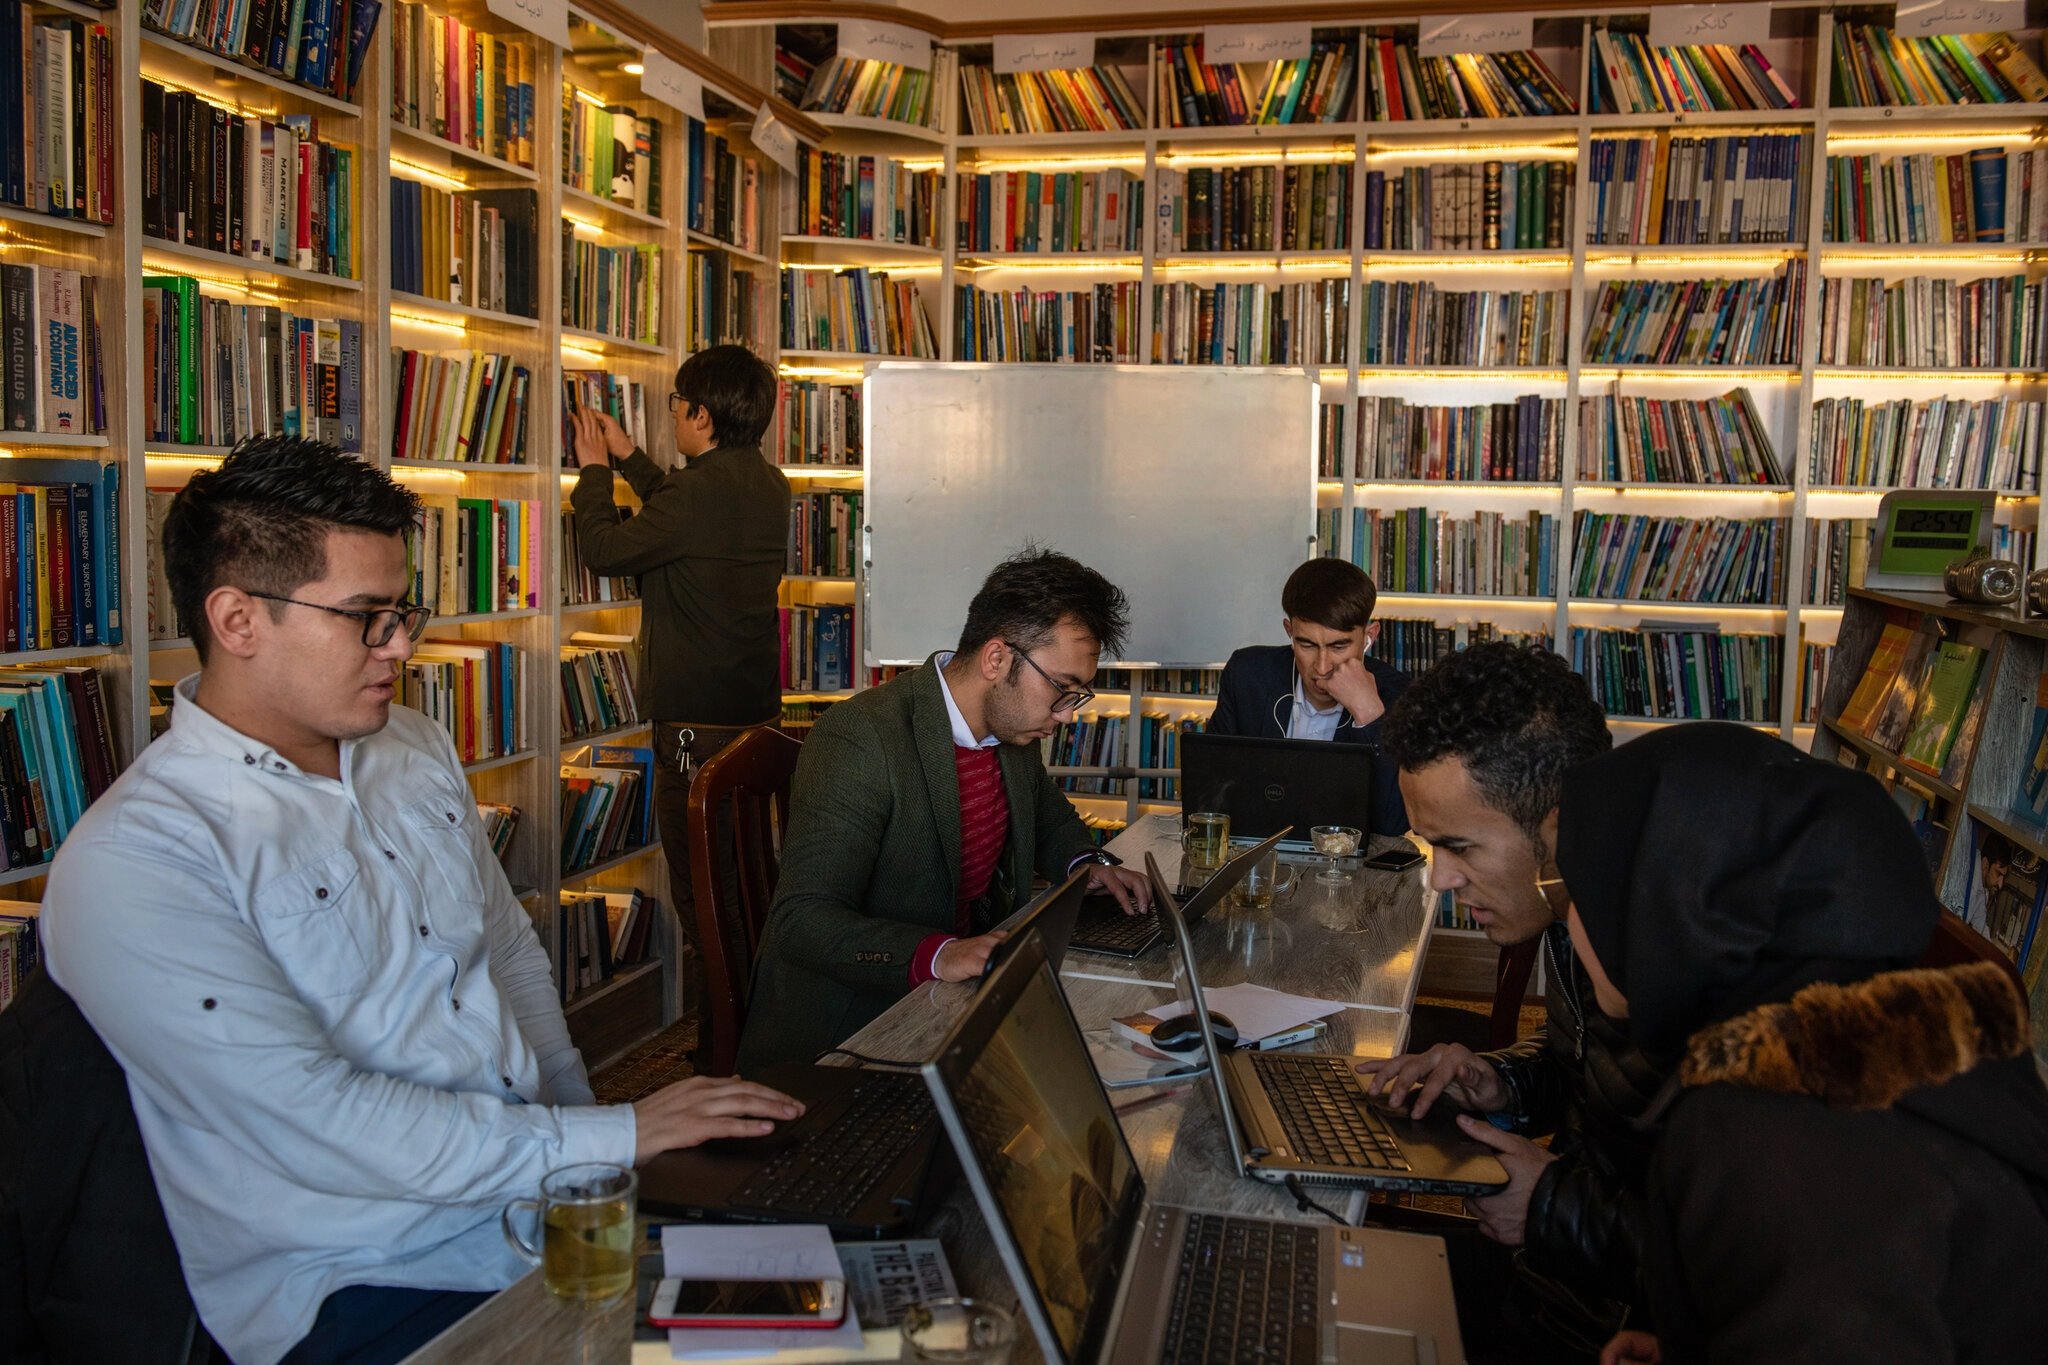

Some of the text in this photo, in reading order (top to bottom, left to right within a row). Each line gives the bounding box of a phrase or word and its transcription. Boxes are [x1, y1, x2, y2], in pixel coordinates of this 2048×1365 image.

[1685, 12, 1733, 35] کانکور
[1920, 7, 2003, 28] روان شناسی
[1013, 46, 1077, 64] علوم سیاسی
[1214, 39, 1245, 53] فلسفی
[1282, 36, 1303, 50] علوم
[50, 89, 65, 132] THEORY
[1675, 115, 1683, 123] N
[150, 131, 160, 196] ACCOUNTING
[214, 127, 226, 207] Accounting
[55, 183, 63, 206] USED
[280, 157, 288, 230] MARKETING
[17, 290, 26, 322] THOMAS
[63, 301, 72, 316] Gupta
[287, 320, 295, 352] ELECTRICAL
[12, 326, 26, 401] CALCULUS
[49, 318, 64, 398] ACCOUNTANCY
[63, 322, 78, 401] ADVANCED
[237, 338, 245, 390] MANAGEMENT
[305, 334, 315, 408] Management
[341, 350, 352, 372] Law
[348, 334, 359, 389] Mercantile
[272, 353, 282, 418] THERMODYNAMICS
[289, 373, 297, 407] CAPACITORS
[325, 366, 338, 418] HTML
[1910, 510, 1964, 532] 2:54
[54, 509, 64, 612] SharePoint 2010 Development
[80, 510, 92, 609] ELEMENTARY SURVEYING
[91, 696, 103, 736] Fundamentals
[1, 785, 13, 824] Anthropology
[1, 948, 10, 1001] MASTERING
[871, 1243, 912, 1273] THE
